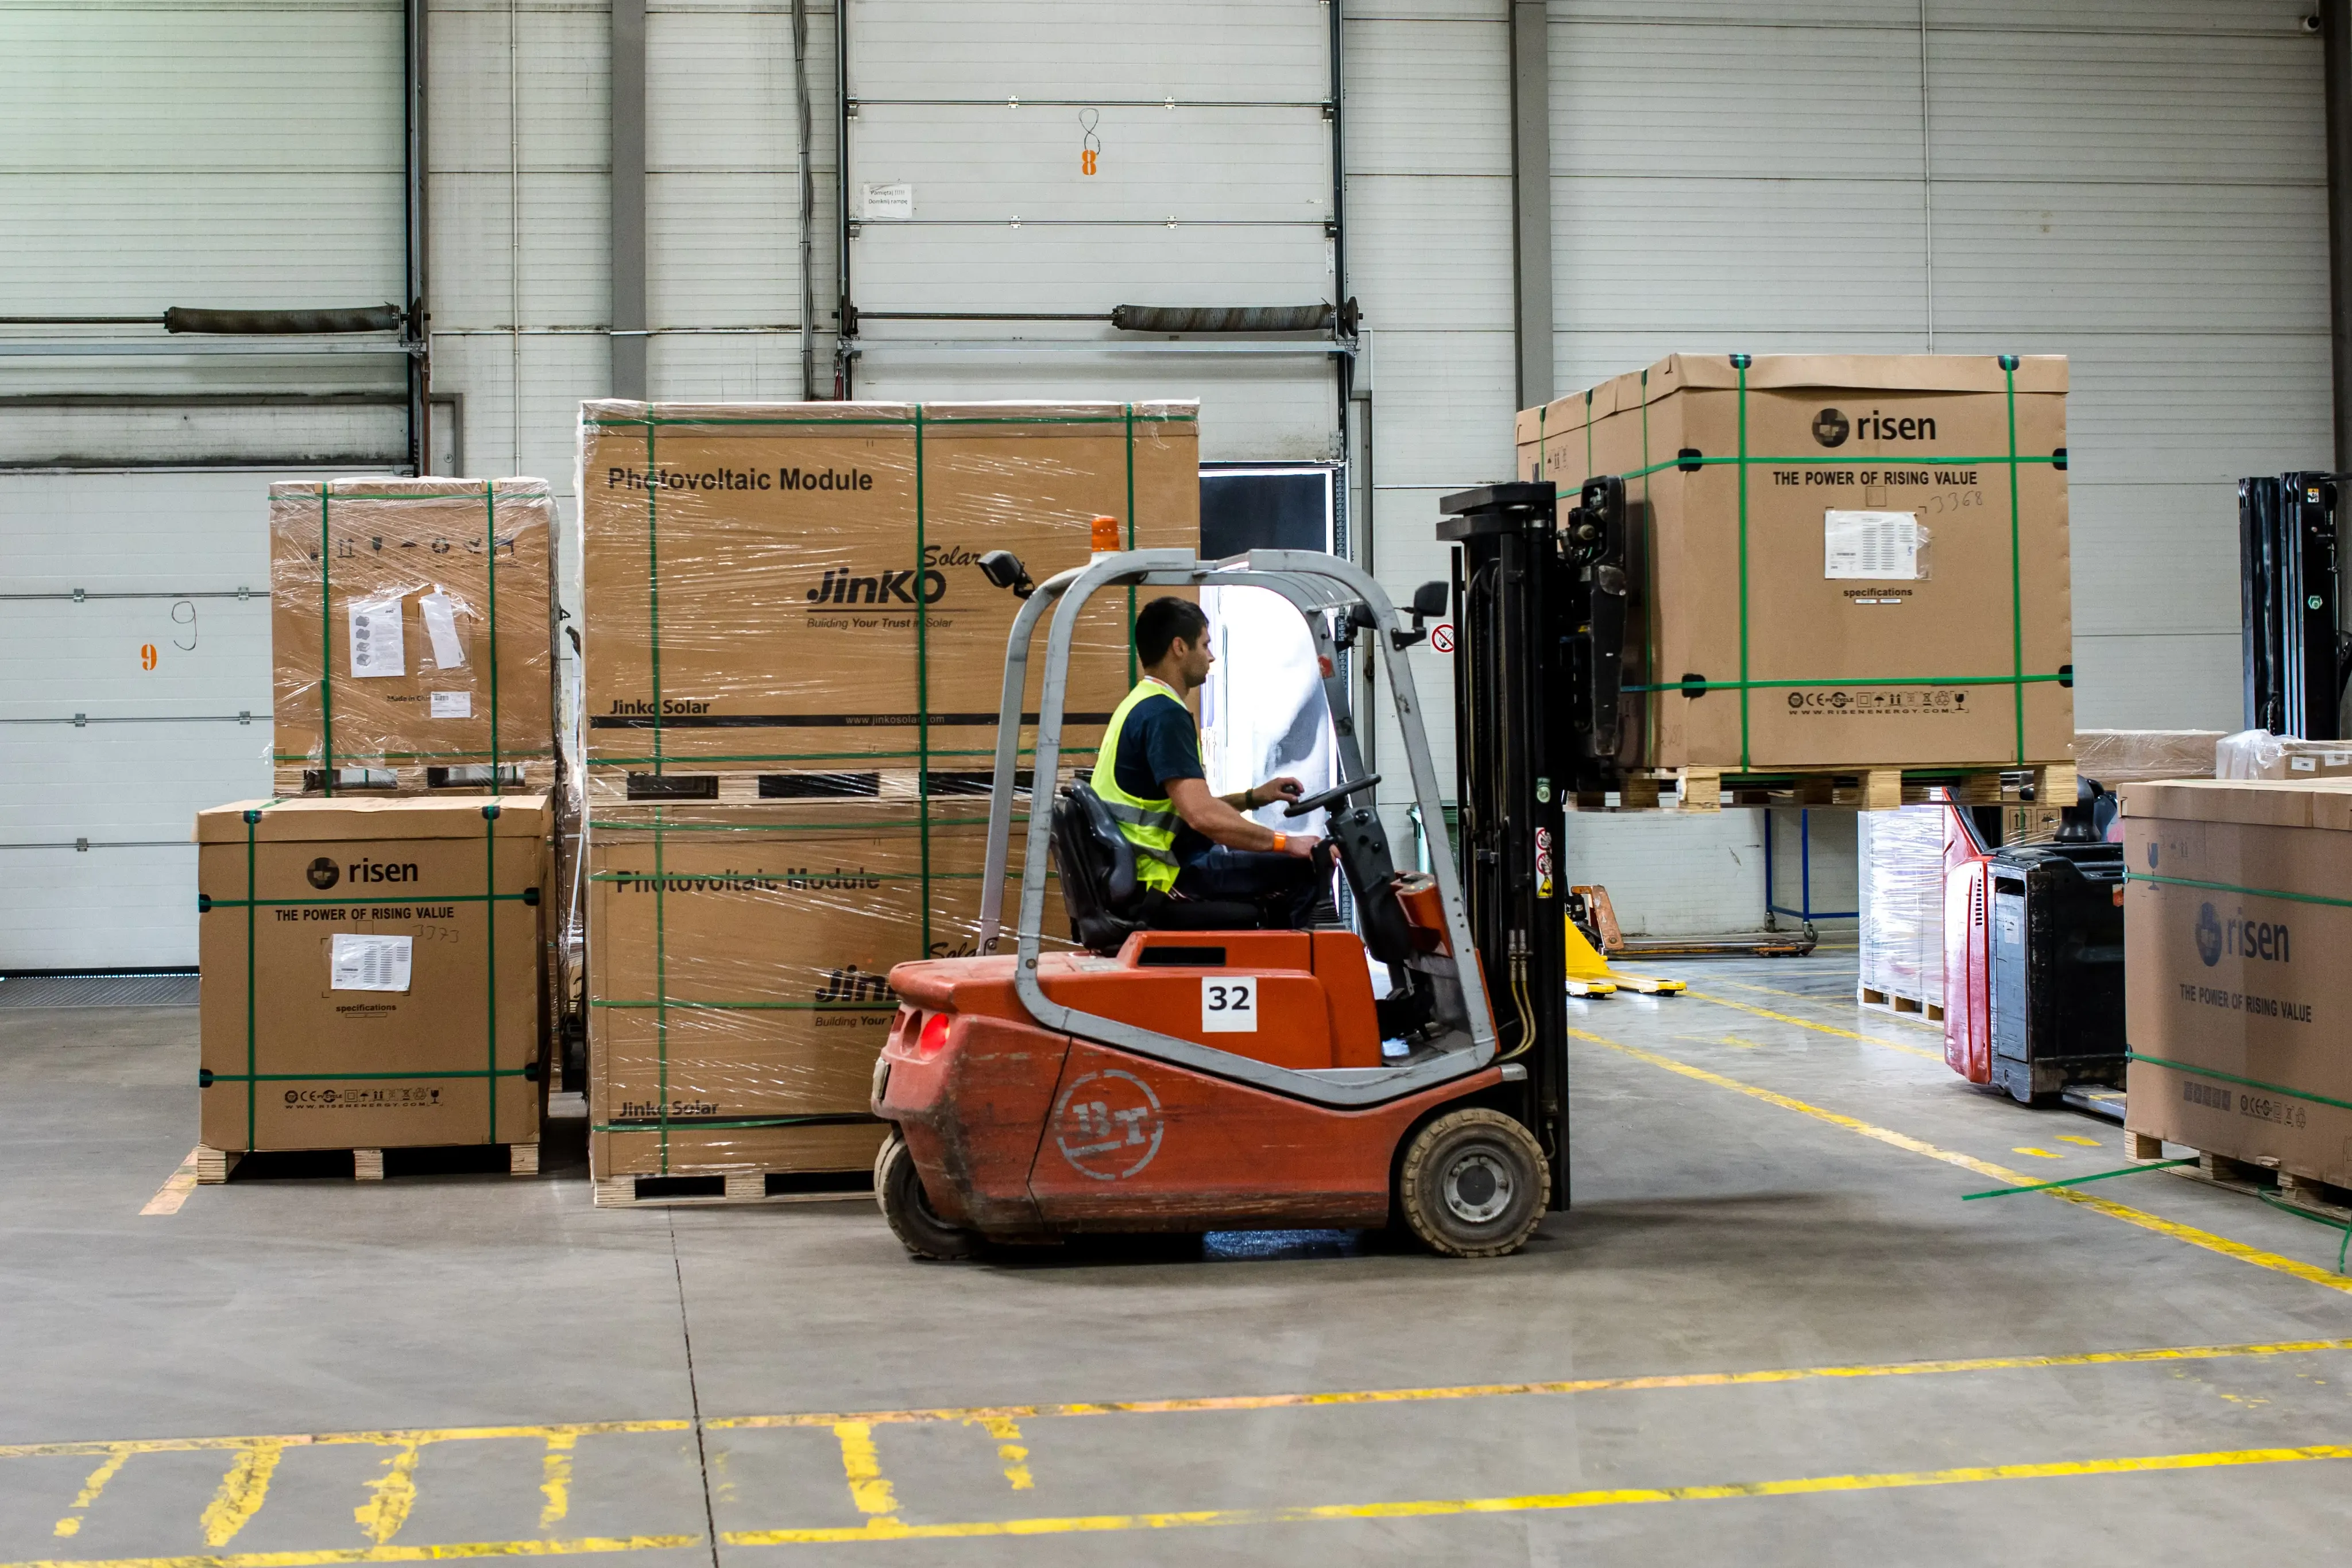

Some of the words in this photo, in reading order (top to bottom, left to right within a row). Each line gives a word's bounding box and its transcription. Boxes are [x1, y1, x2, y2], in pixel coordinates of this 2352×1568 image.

[1082, 150, 1097, 175] 8
[1857, 409, 1936, 440] risen
[609, 467, 771, 490] Photovoltaic
[780, 468, 873, 491] Module
[1773, 471, 1799, 485] THE
[1805, 471, 1854, 485] POWER
[1860, 471, 1878, 485] OF
[1885, 471, 1929, 485] RISING
[1935, 471, 1978, 485] VALUE
[1931, 490, 1983, 513] 3368
[919, 545, 981, 568] Solar
[1843, 587, 1913, 598] specifications
[807, 618, 848, 630] Building
[852, 618, 879, 628] Your
[882, 618, 911, 628] Trust
[925, 617, 953, 628] Solar
[141, 644, 157, 671] 9
[663, 699, 710, 714] Solar
[349, 857, 418, 882] risen
[787, 868, 880, 891] Module
[275, 909, 298, 921] THE
[303, 908, 345, 920] POWER
[351, 908, 366, 920] OF
[372, 907, 411, 919] RISING
[416, 907, 454, 918] VALUE
[2227, 907, 2289, 963] risen
[815, 965, 896, 1002] Jin
[336, 1004, 397, 1013] specifications
[1208, 986, 1250, 1011] 32
[2180, 984, 2196, 1001] THE
[2199, 986, 2229, 1008] POWER
[2231, 993, 2242, 1009] OF
[2246, 995, 2277, 1017] RISING
[2281, 1001, 2311, 1023] VALUE
[815, 1017, 857, 1028] Building
[861, 1016, 887, 1025] Your
[672, 1100, 719, 1116] Solar
[1072, 1101, 1148, 1145] BT
